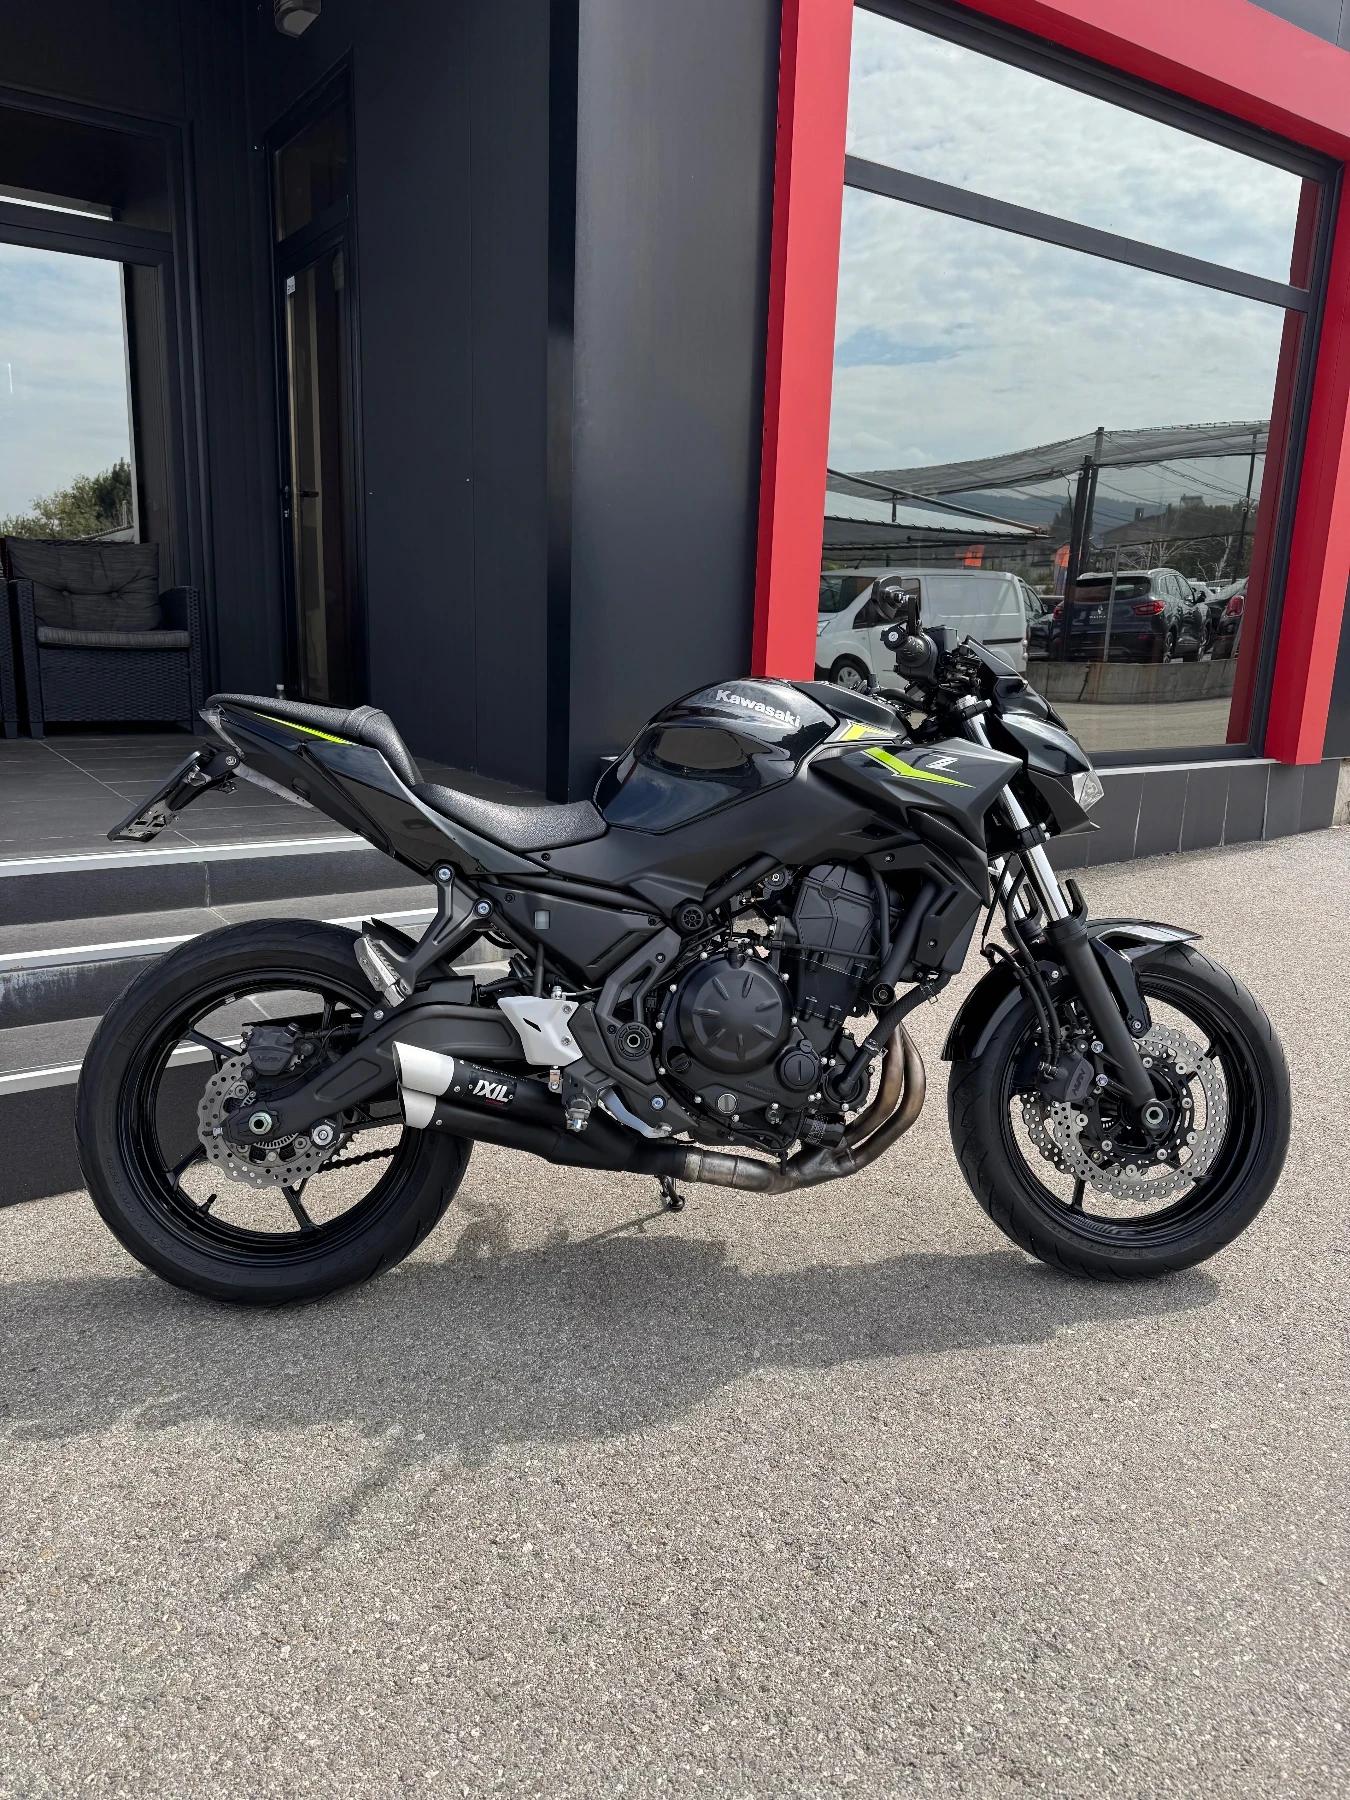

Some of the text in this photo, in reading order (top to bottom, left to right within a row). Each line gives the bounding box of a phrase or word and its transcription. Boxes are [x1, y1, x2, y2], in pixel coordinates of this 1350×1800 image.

[715, 689, 801, 727] Kawasaki
[925, 752, 960, 774] Z
[472, 1080, 509, 1102] IXIL
